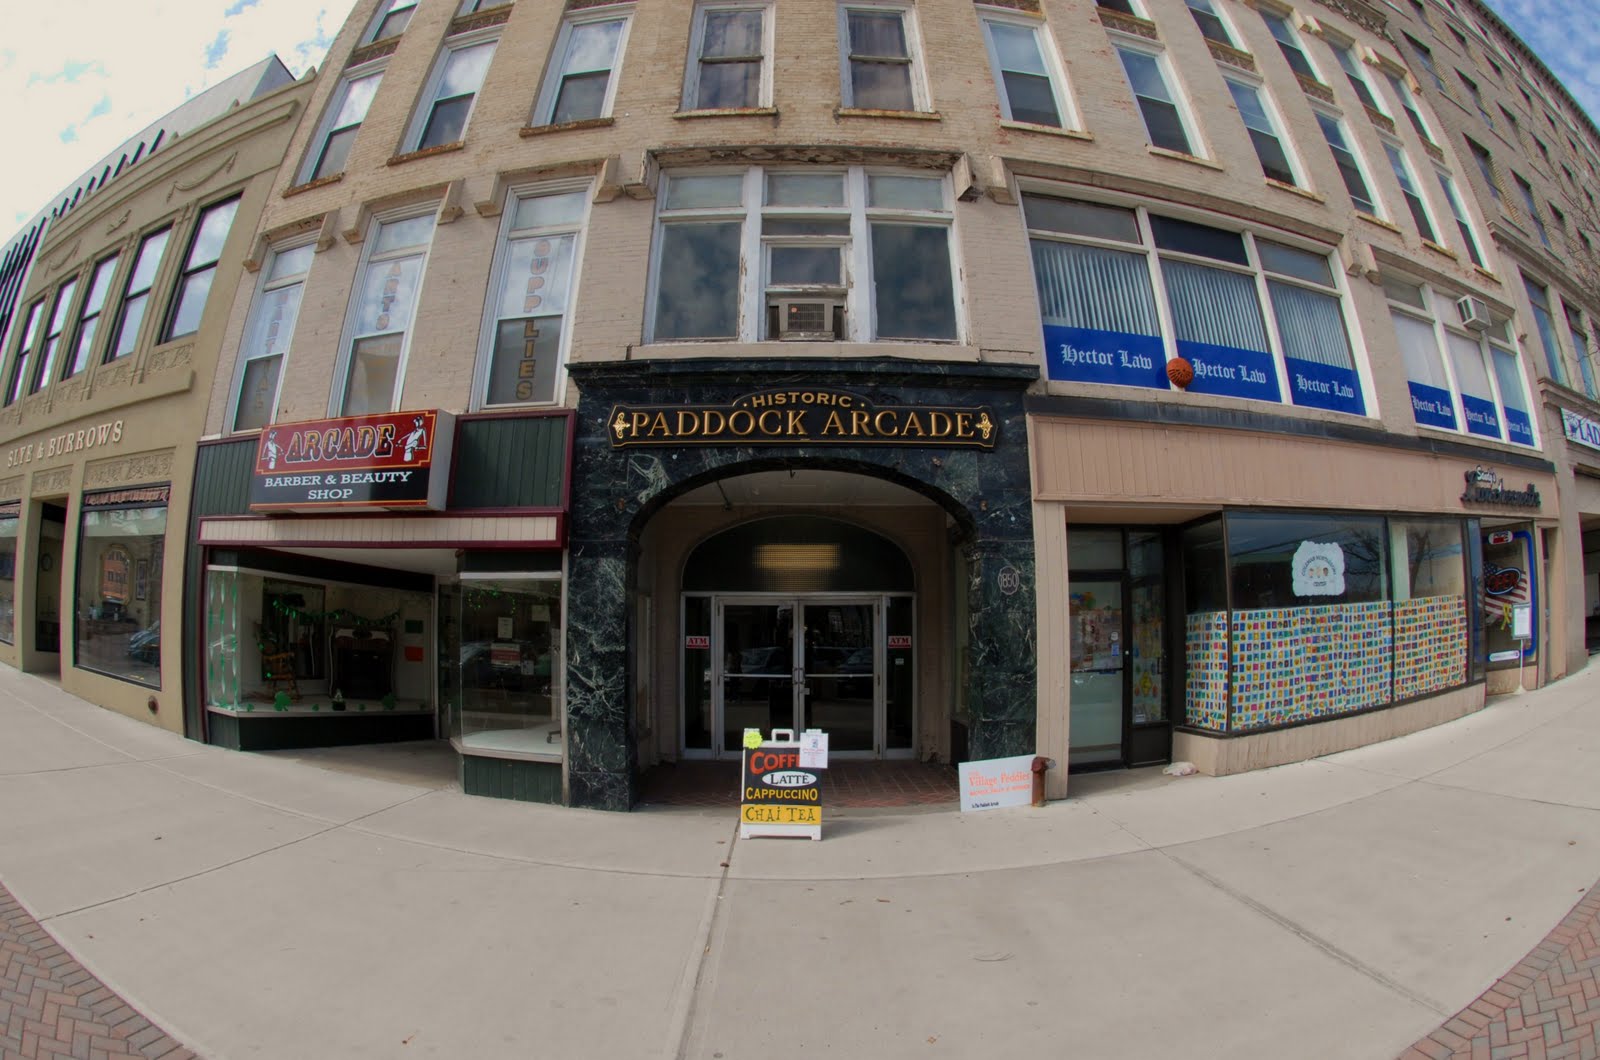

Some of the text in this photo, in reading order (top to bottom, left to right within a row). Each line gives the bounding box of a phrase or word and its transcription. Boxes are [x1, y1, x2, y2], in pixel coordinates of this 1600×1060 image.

[515, 239, 552, 400] SUPPLIES
[1060, 344, 1153, 370] Hector Law
[1192, 358, 1267, 384] Hector Law
[1296, 374, 1355, 399] Hector Law
[752, 391, 853, 409] HISTORIC
[629, 409, 975, 438] PADDOCK ARCADE
[7, 419, 125, 468] SLYE & BURROWS
[285, 423, 396, 464] ARCADE
[264, 471, 413, 488] BARBER & BEAUTY
[308, 488, 353, 500] SHOP
[688, 637, 707, 645] ATM
[890, 637, 909, 645] ATM
[746, 787, 818, 801] CAPPUCCINO
[786, 807, 816, 822] TEA
